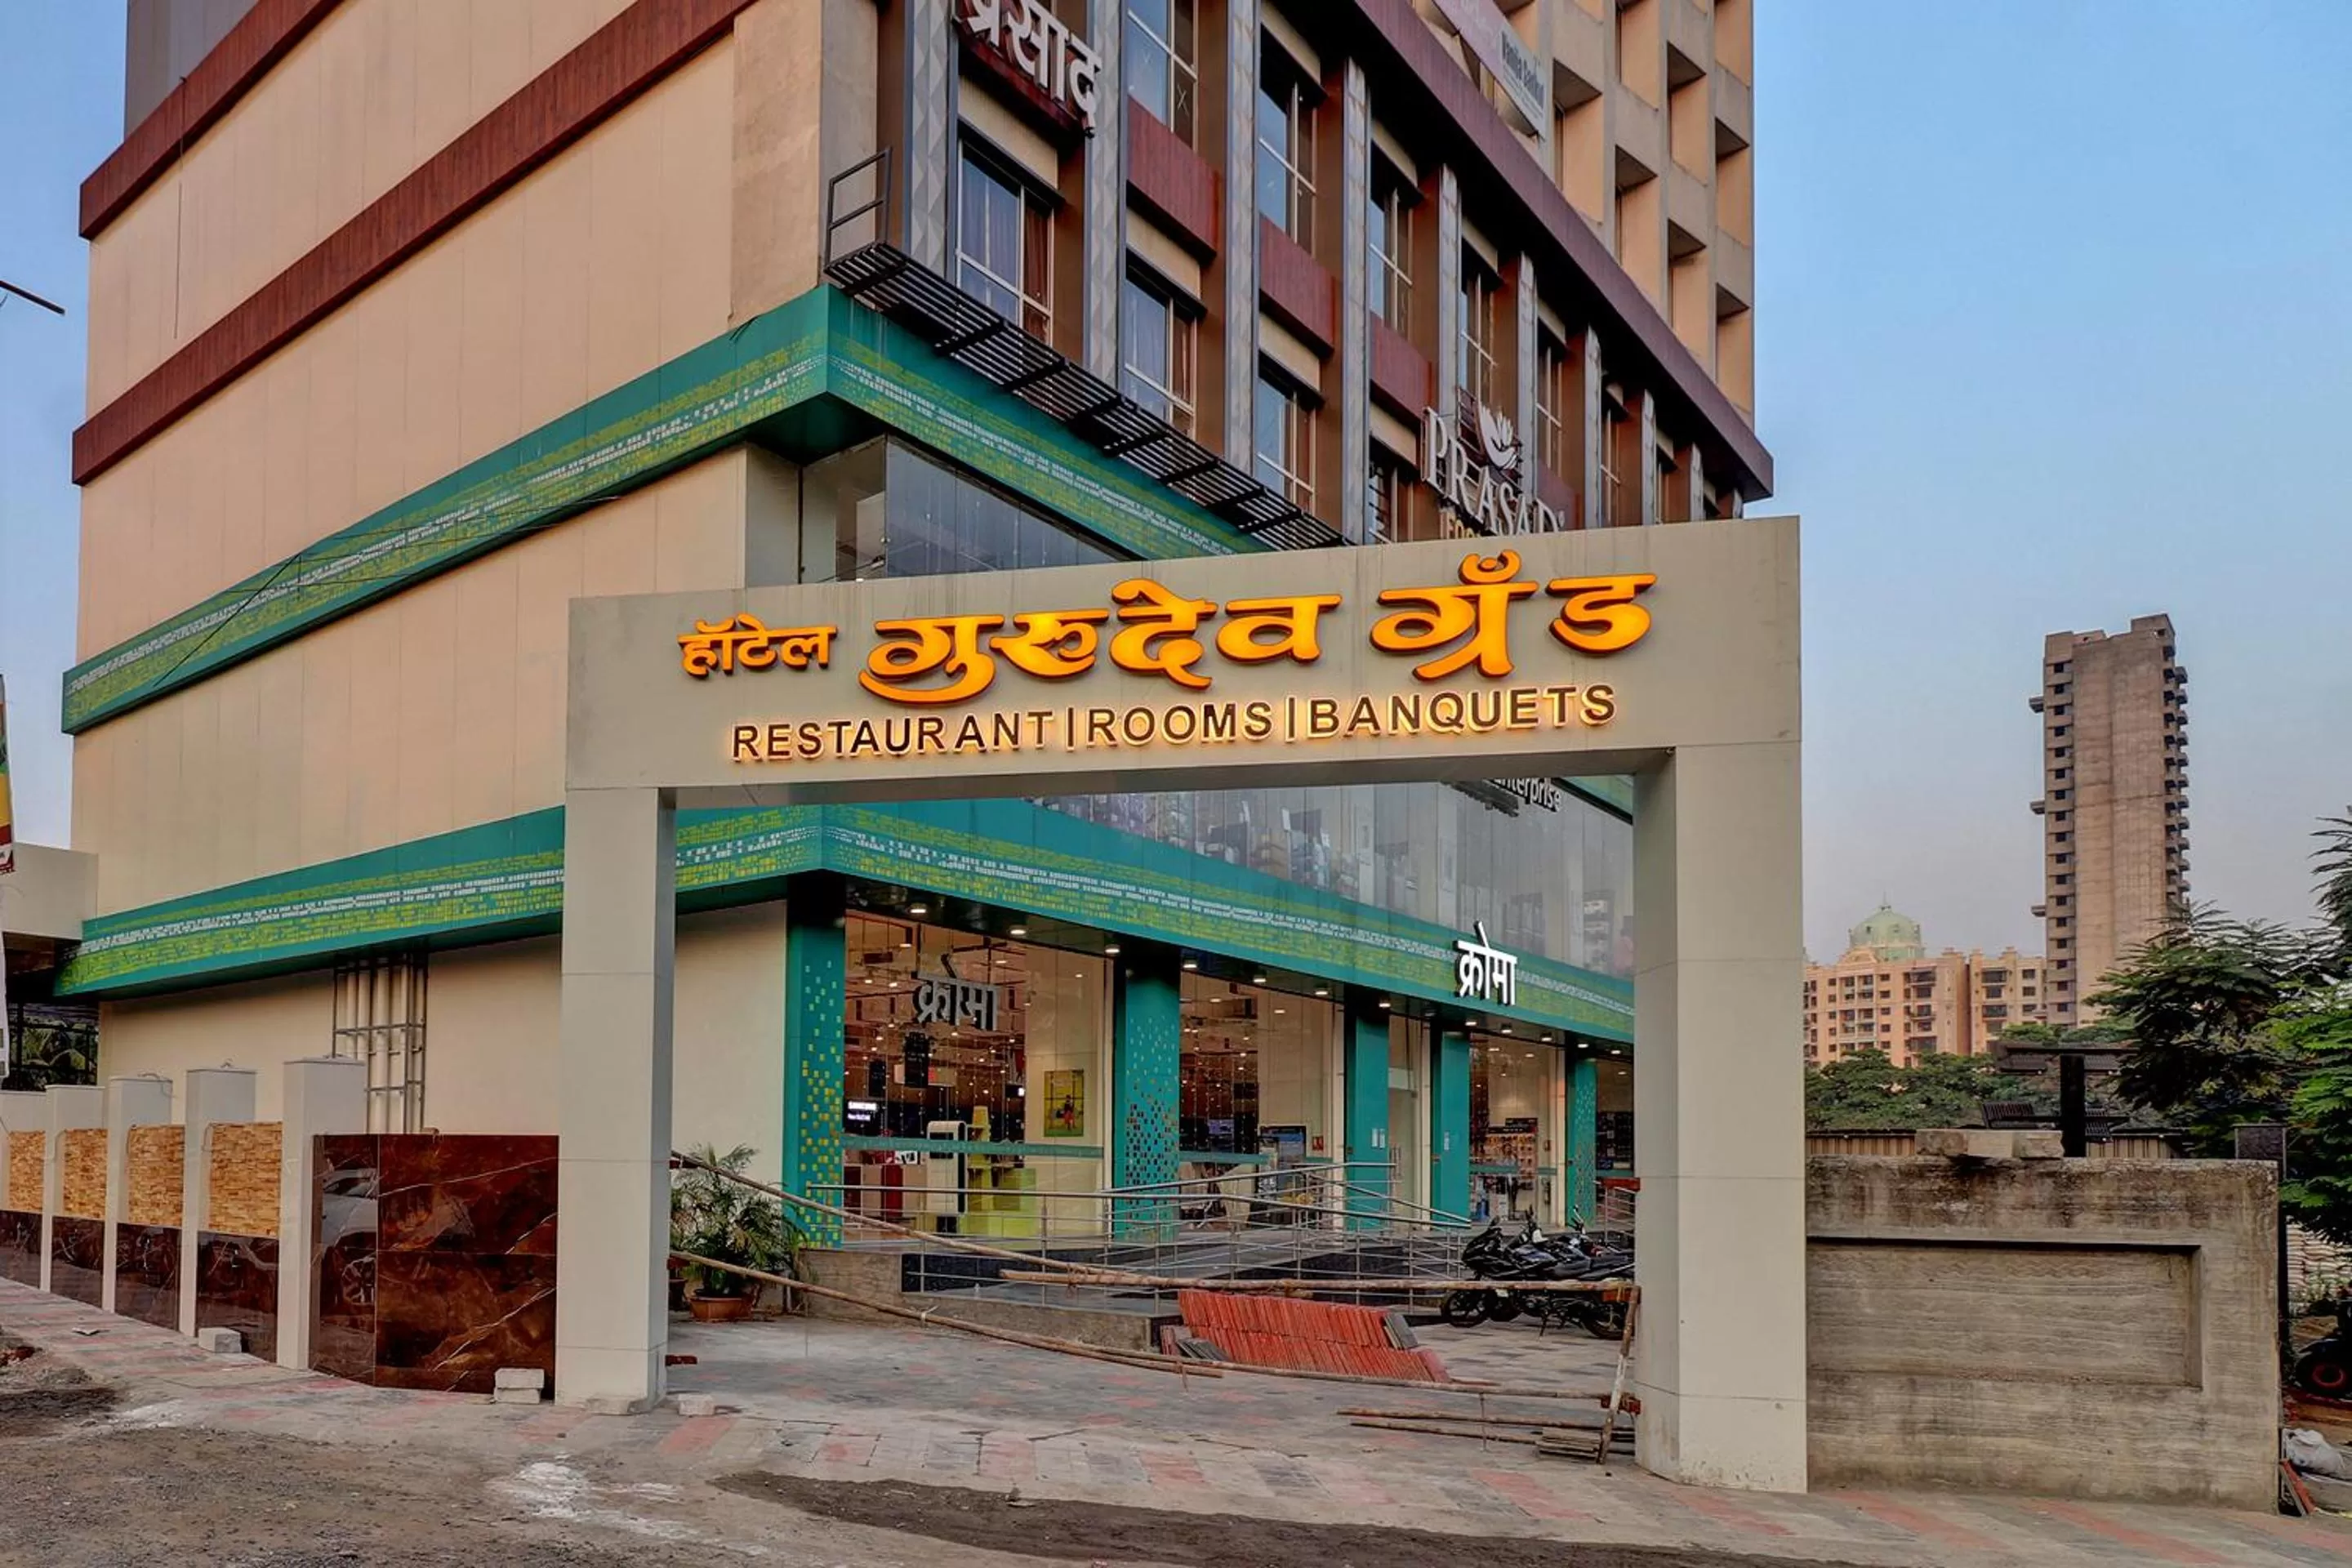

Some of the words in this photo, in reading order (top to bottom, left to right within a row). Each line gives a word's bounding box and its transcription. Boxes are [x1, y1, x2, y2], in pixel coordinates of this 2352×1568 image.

[1420, 407, 1559, 534] PRASAD
[678, 614, 837, 679] हॉटेल
[859, 578, 1342, 705] गुरुदेव
[733, 710, 1054, 762] RESTAURANT
[1087, 701, 1273, 746] ROOMS
[1308, 684, 1616, 736] BANQUETS
[1493, 777, 1561, 813] nterprise
[911, 954, 1001, 1031] क्रोमा
[1453, 920, 1517, 1006] क्रोमा
